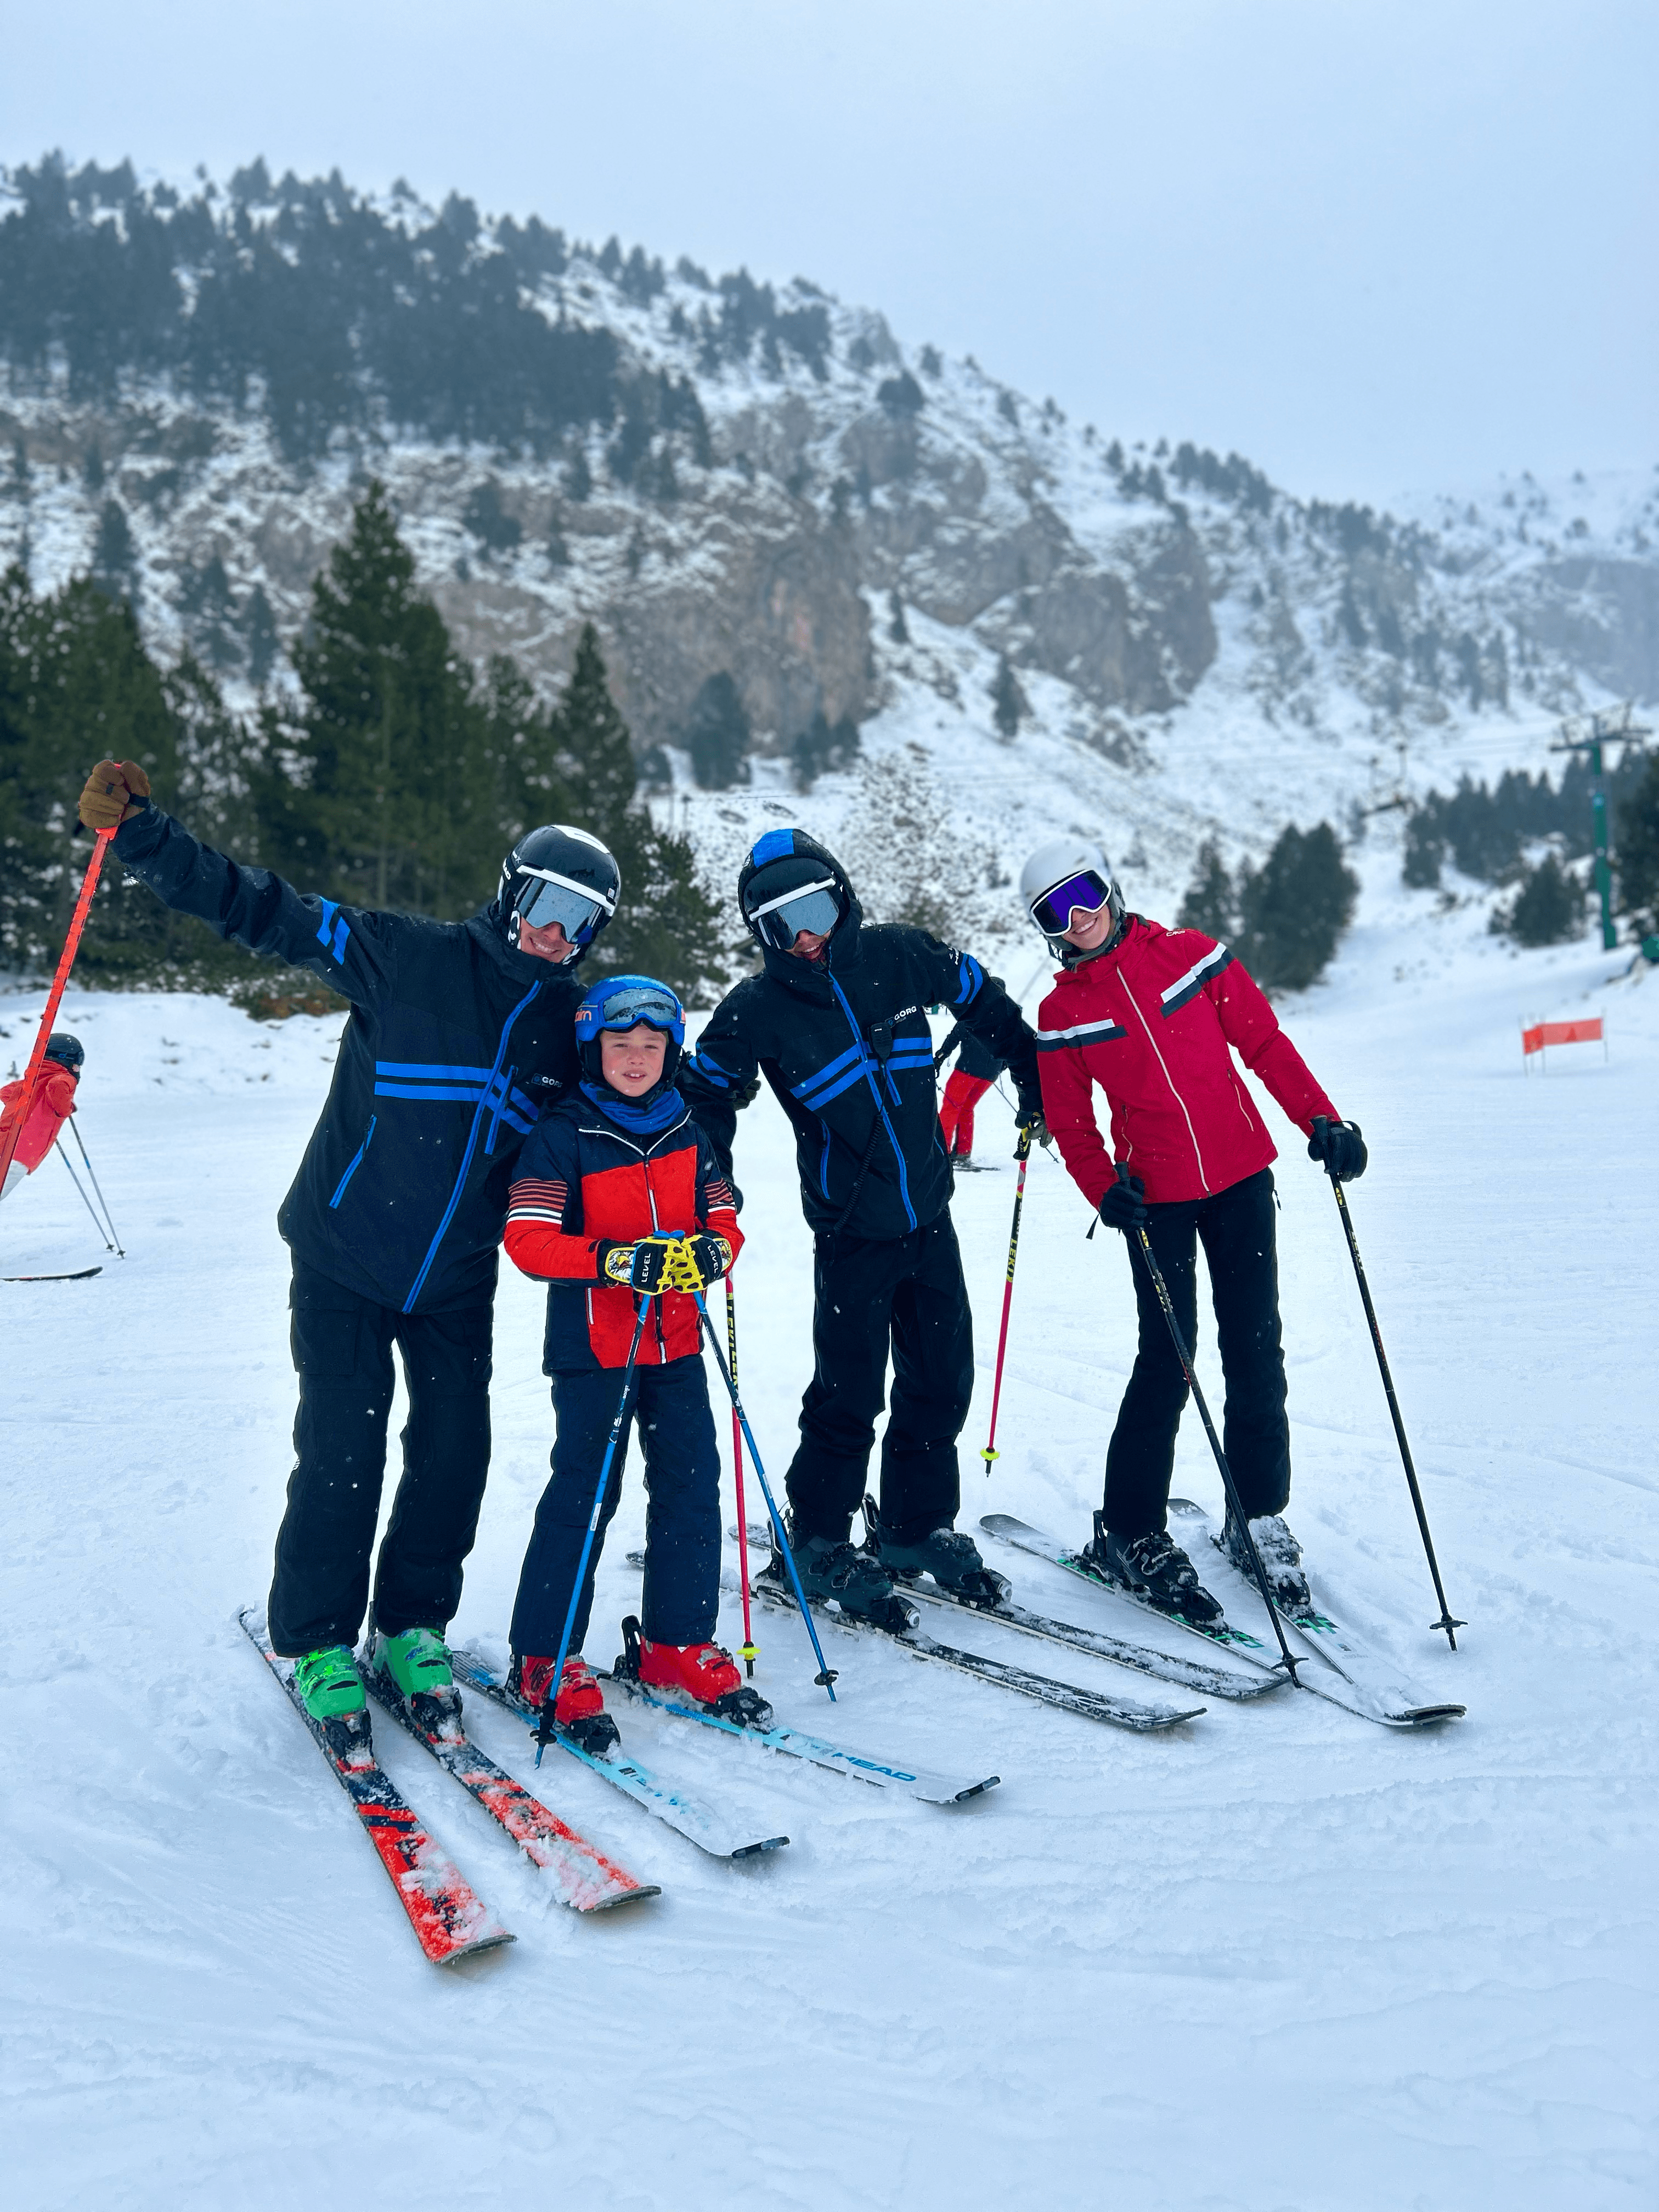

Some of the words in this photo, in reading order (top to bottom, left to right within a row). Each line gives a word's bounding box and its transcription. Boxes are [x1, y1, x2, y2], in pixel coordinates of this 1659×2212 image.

[641, 1252, 651, 1283] LEVEL
[707, 1245, 719, 1274] LEVEL
[1008, 1238, 1018, 1273] LEKI
